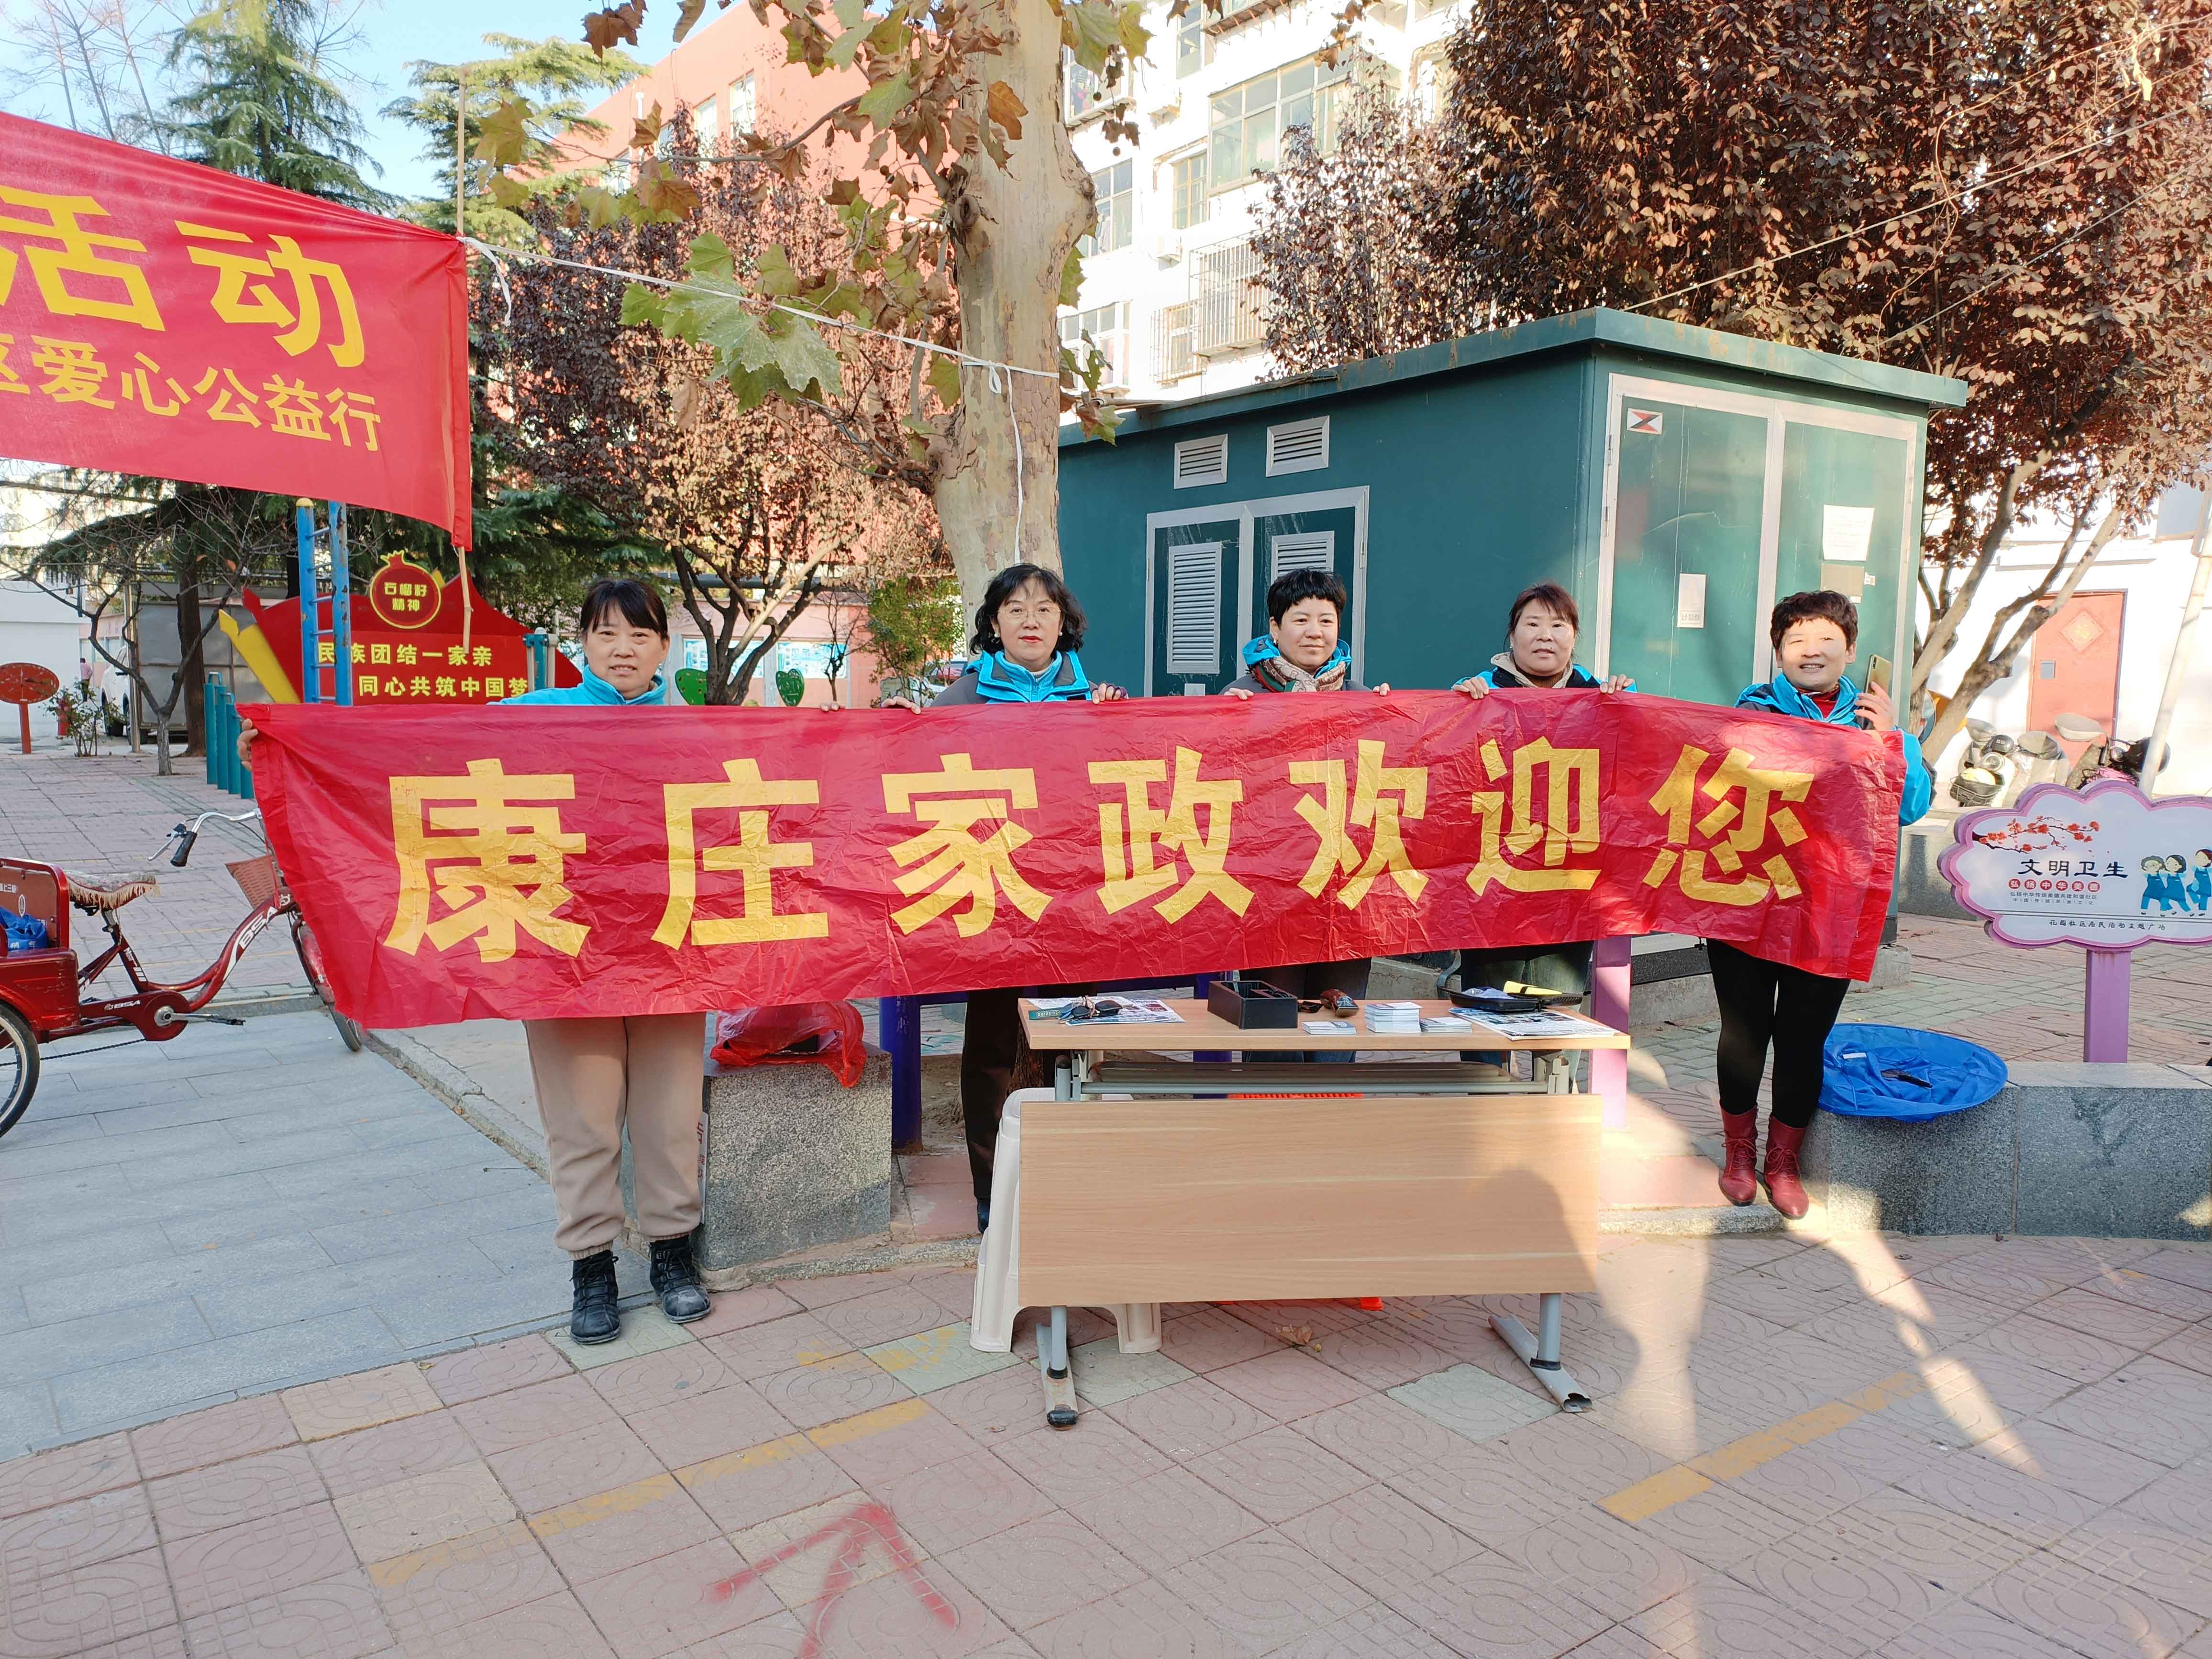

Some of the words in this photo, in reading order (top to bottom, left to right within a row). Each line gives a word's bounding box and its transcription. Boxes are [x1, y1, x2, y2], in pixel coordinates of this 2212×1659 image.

[0, 185, 365, 367] 活动
[318, 642, 492, 666] 民族团结一家亲
[359, 676, 528, 697] 同心共筑中国梦
[384, 737, 1815, 962] 康庄家政欢迎您
[2017, 859, 2128, 878] 文明卫生
[2010, 880, 2099, 891] 弘扬中华美德
[239, 906, 278, 950] BSA
[114, 1000, 141, 1009] BSA
